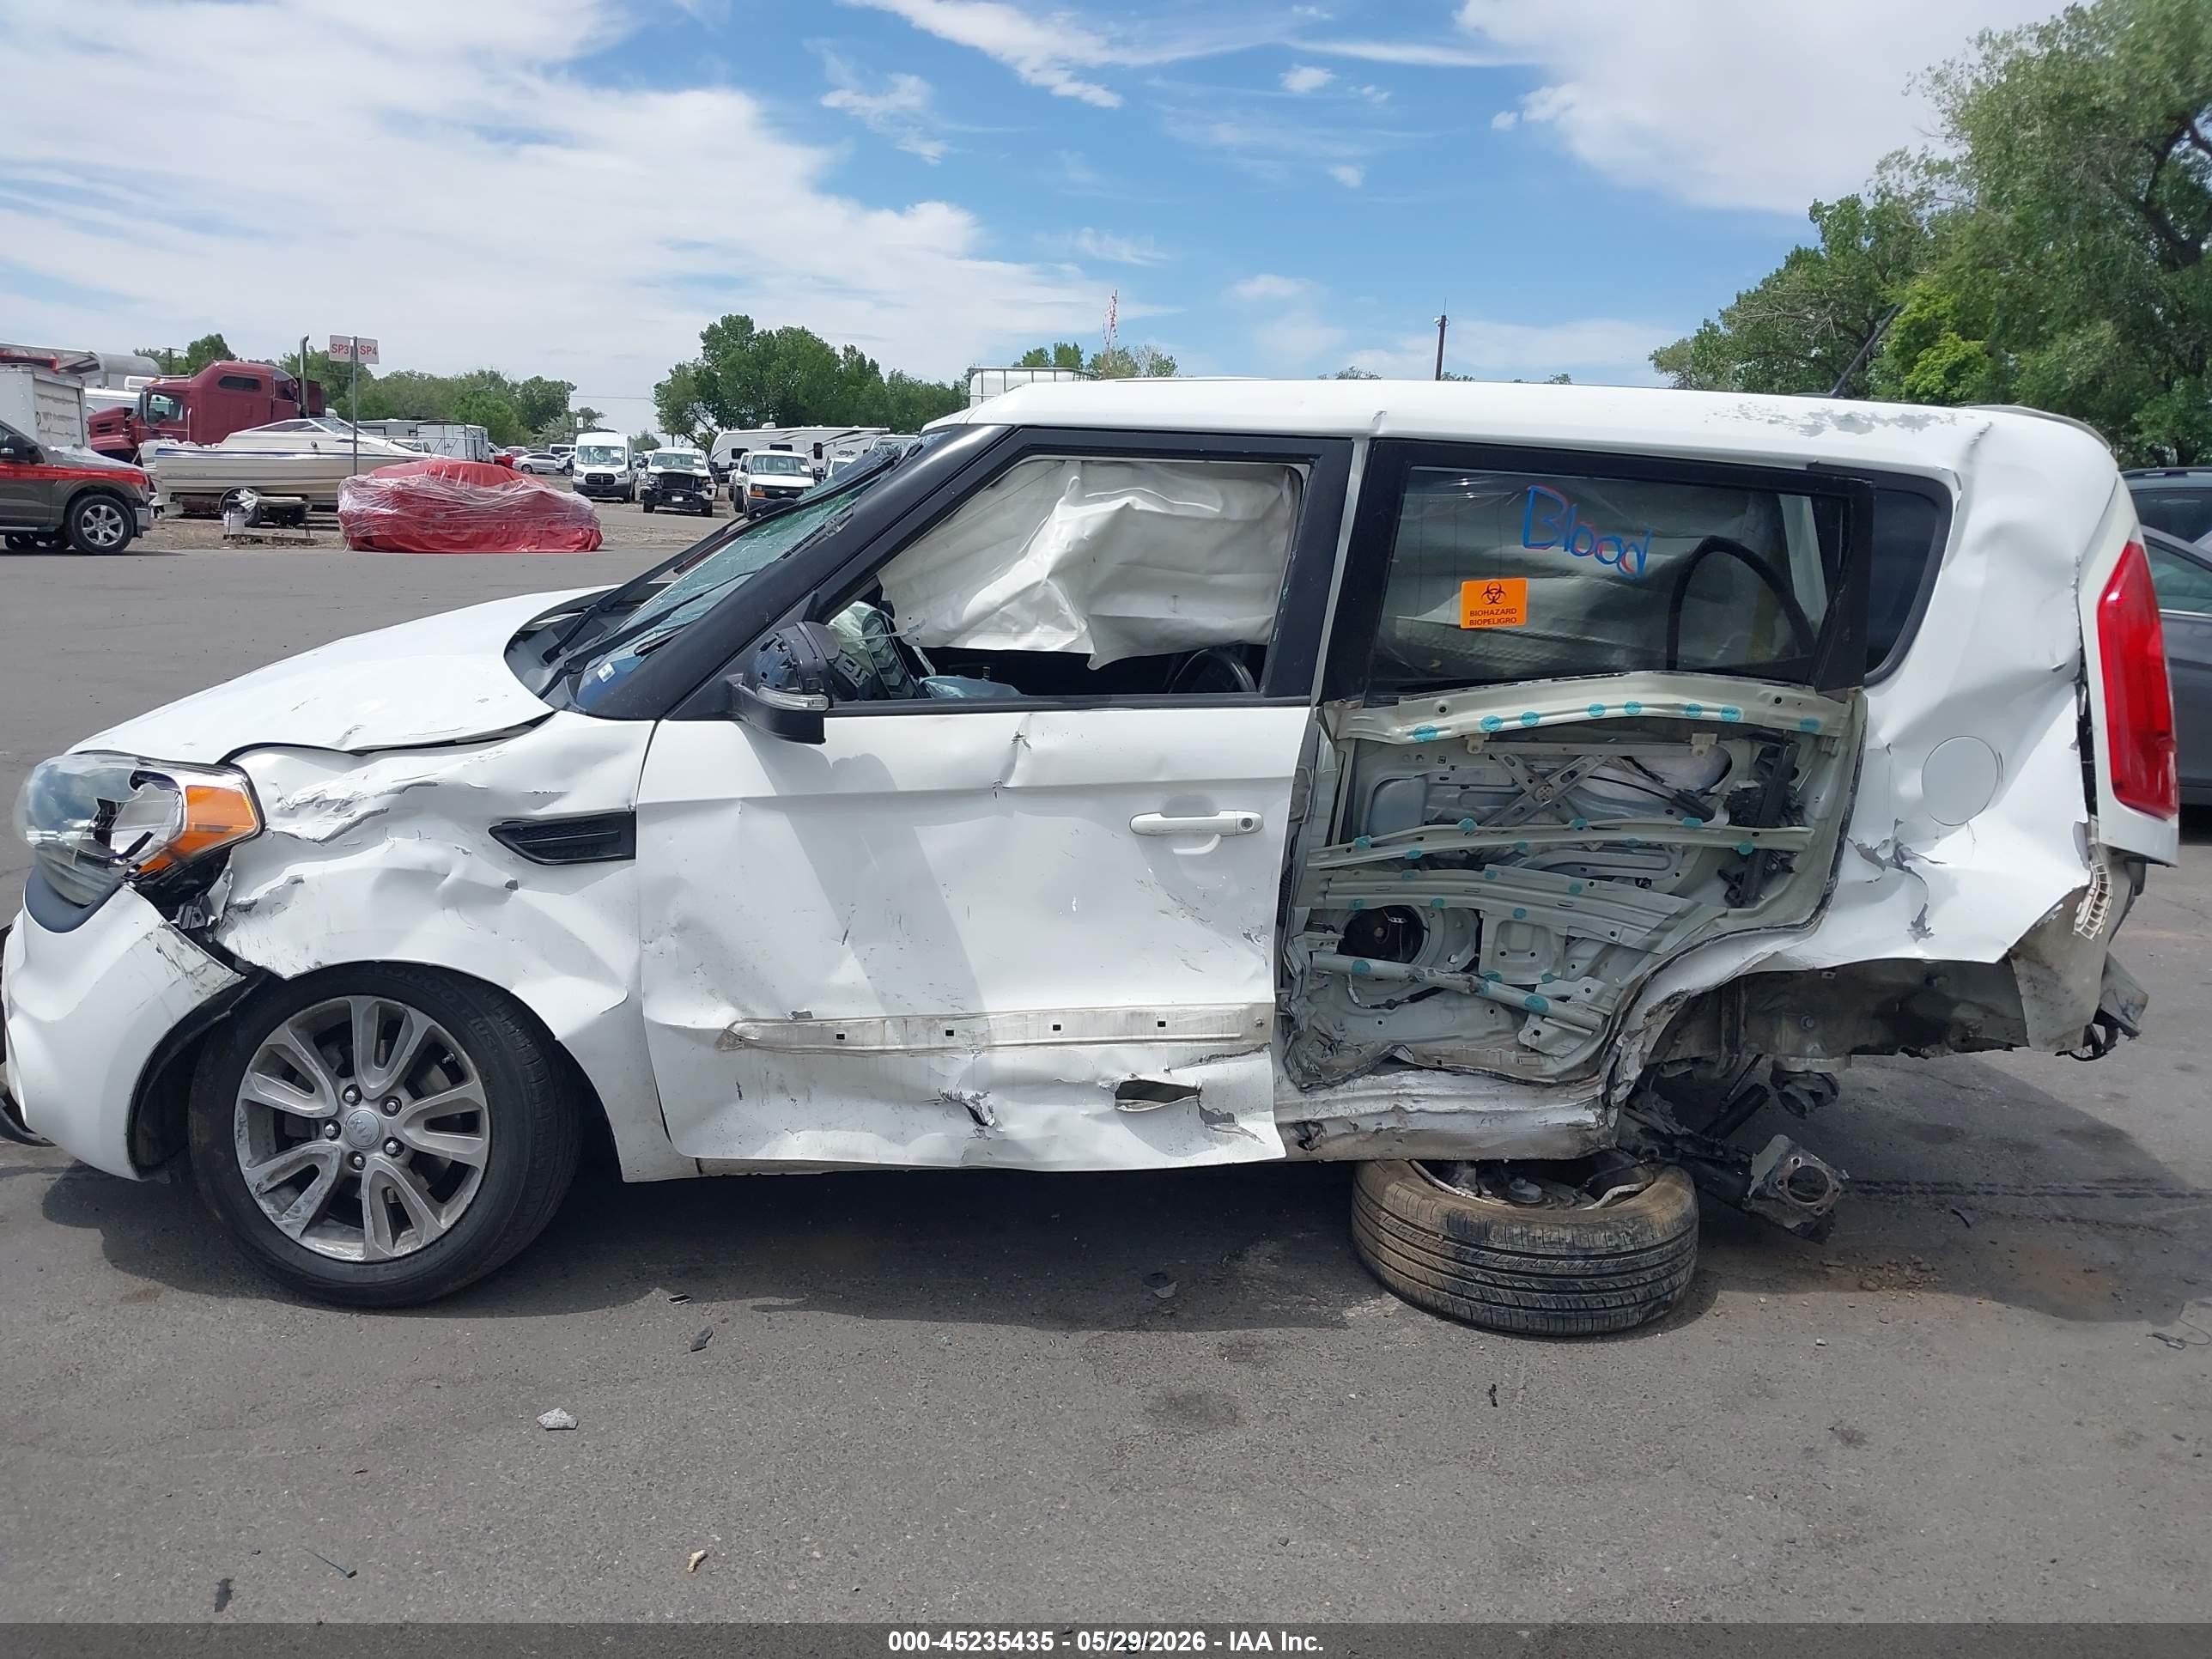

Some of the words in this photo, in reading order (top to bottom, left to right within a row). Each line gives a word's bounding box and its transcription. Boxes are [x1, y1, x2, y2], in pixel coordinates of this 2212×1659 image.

[331, 343, 349, 355] SP3
[360, 345, 378, 356] SP4
[1522, 485, 1653, 579] Blood
[1469, 608, 1517, 617] BIOHAZARD
[1469, 617, 1517, 626] BIOPELIGRO
